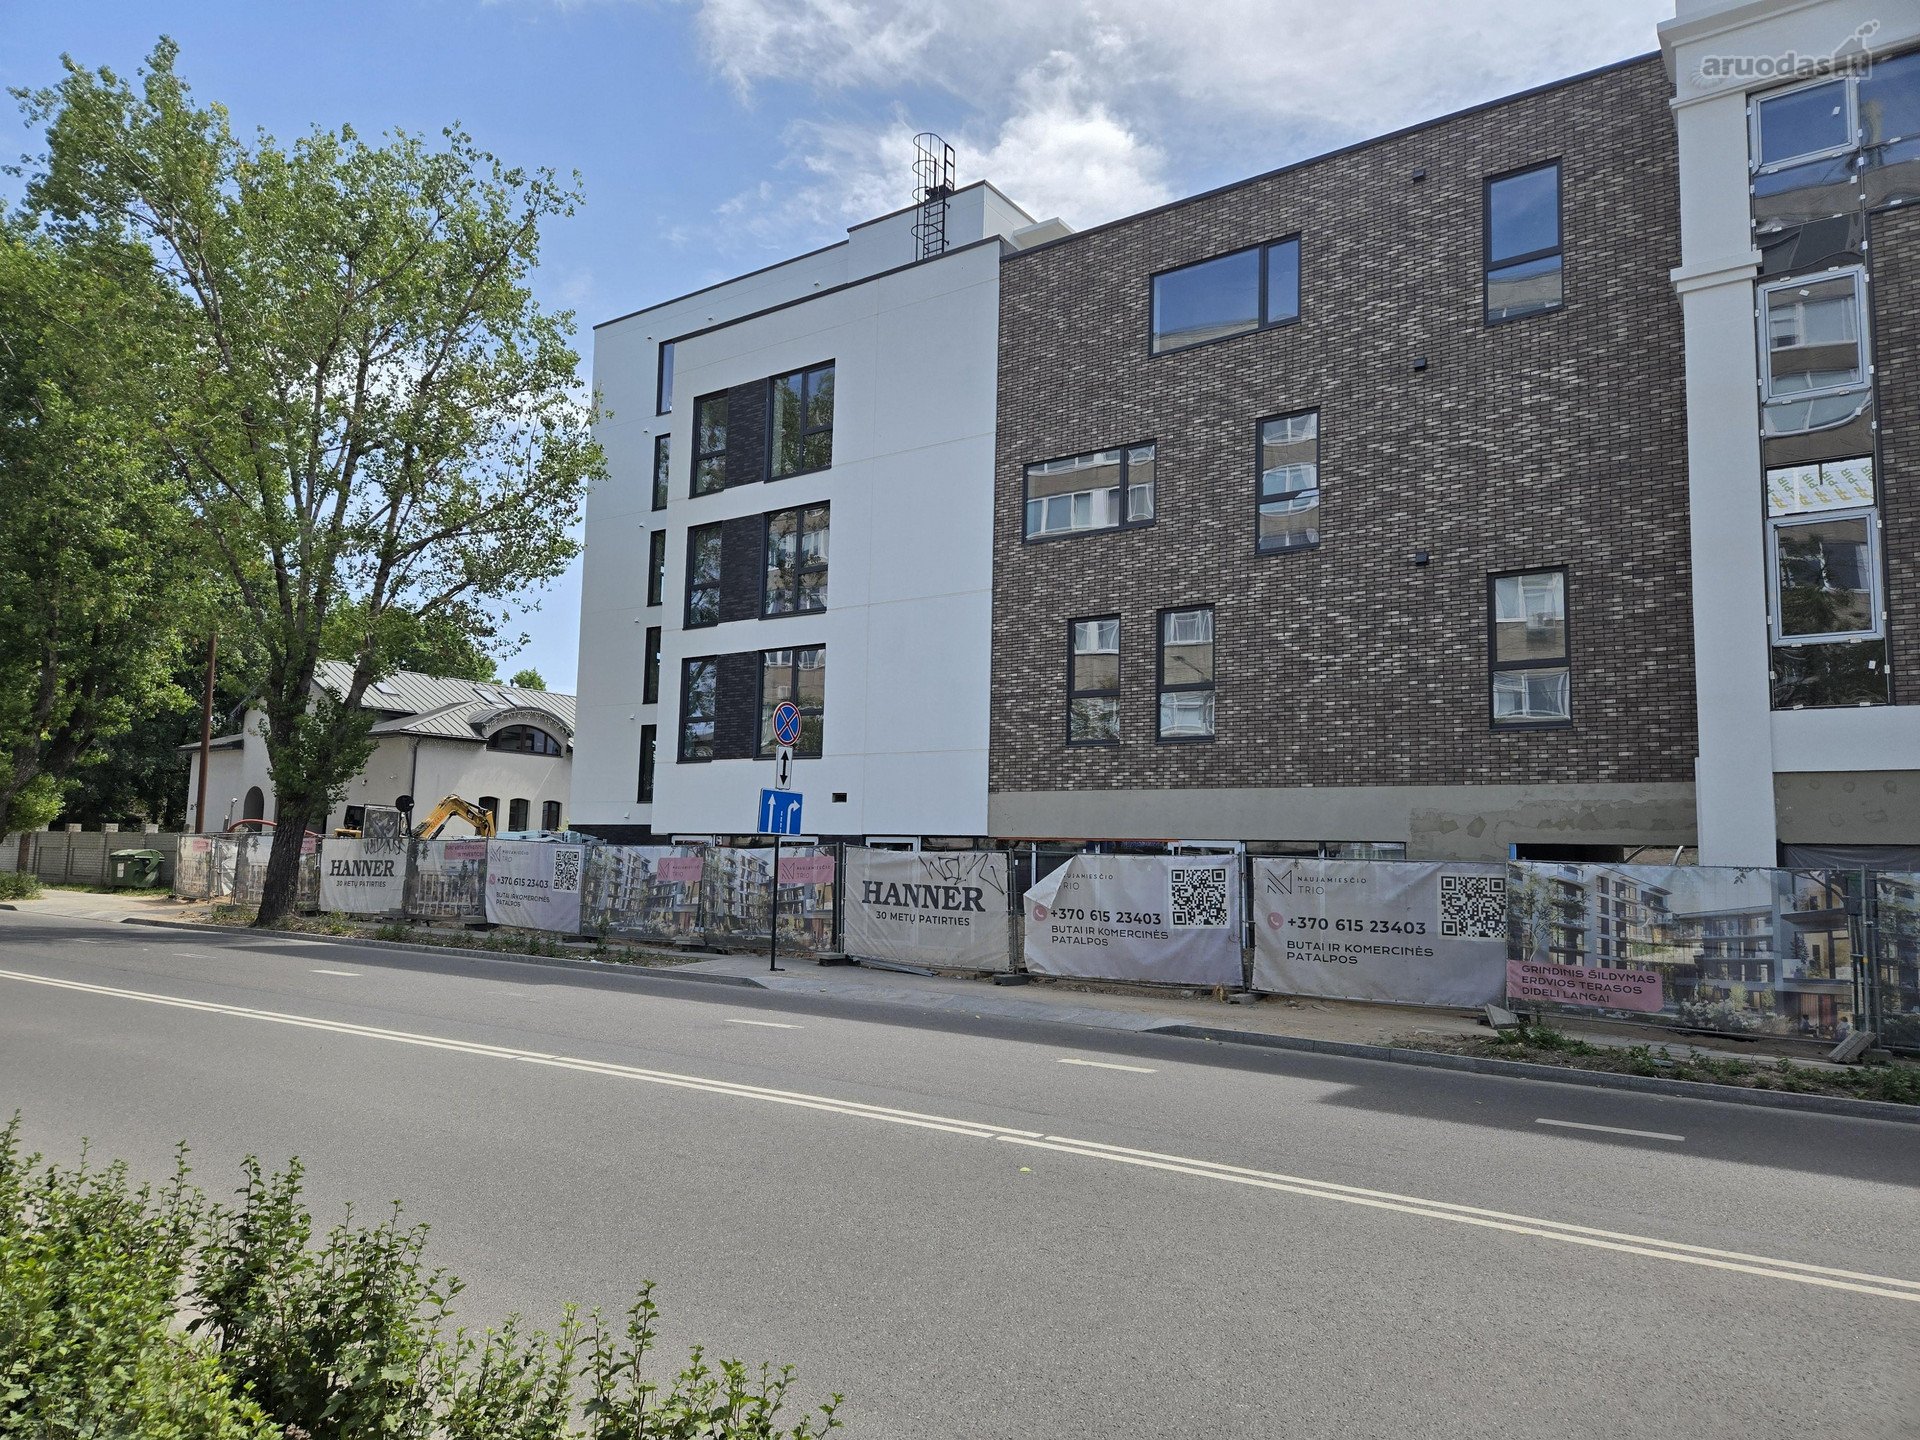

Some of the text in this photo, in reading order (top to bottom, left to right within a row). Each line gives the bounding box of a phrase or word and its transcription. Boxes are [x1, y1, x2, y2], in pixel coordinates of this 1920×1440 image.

[329, 860, 395, 877] HANNER
[497, 877, 549, 888] +370 615 23403
[1061, 882, 1080, 890] RIO
[1297, 875, 1367, 884] NAUJAMIESČIO
[862, 880, 986, 913] HANNER
[1298, 885, 1325, 895] TRIO
[876, 911, 970, 926] 30 METŲ PATIRTIES
[1050, 908, 1162, 925] +370 615 23403
[1051, 925, 1169, 940] BUTAI IR KOMERCINĖS
[1287, 916, 1426, 935] +370 615 23403
[1052, 936, 1109, 946] PATALPOS
[1287, 940, 1434, 957] BUTAI IR KOMERCINĖS
[1287, 952, 1358, 965] PATALPOS
[1522, 965, 1656, 984] GRINDINIS ŠILDYMAS
[1522, 976, 1643, 994] ERDVIOS TERASOS
[1522, 987, 1610, 1004] DIDELI LANGAI
